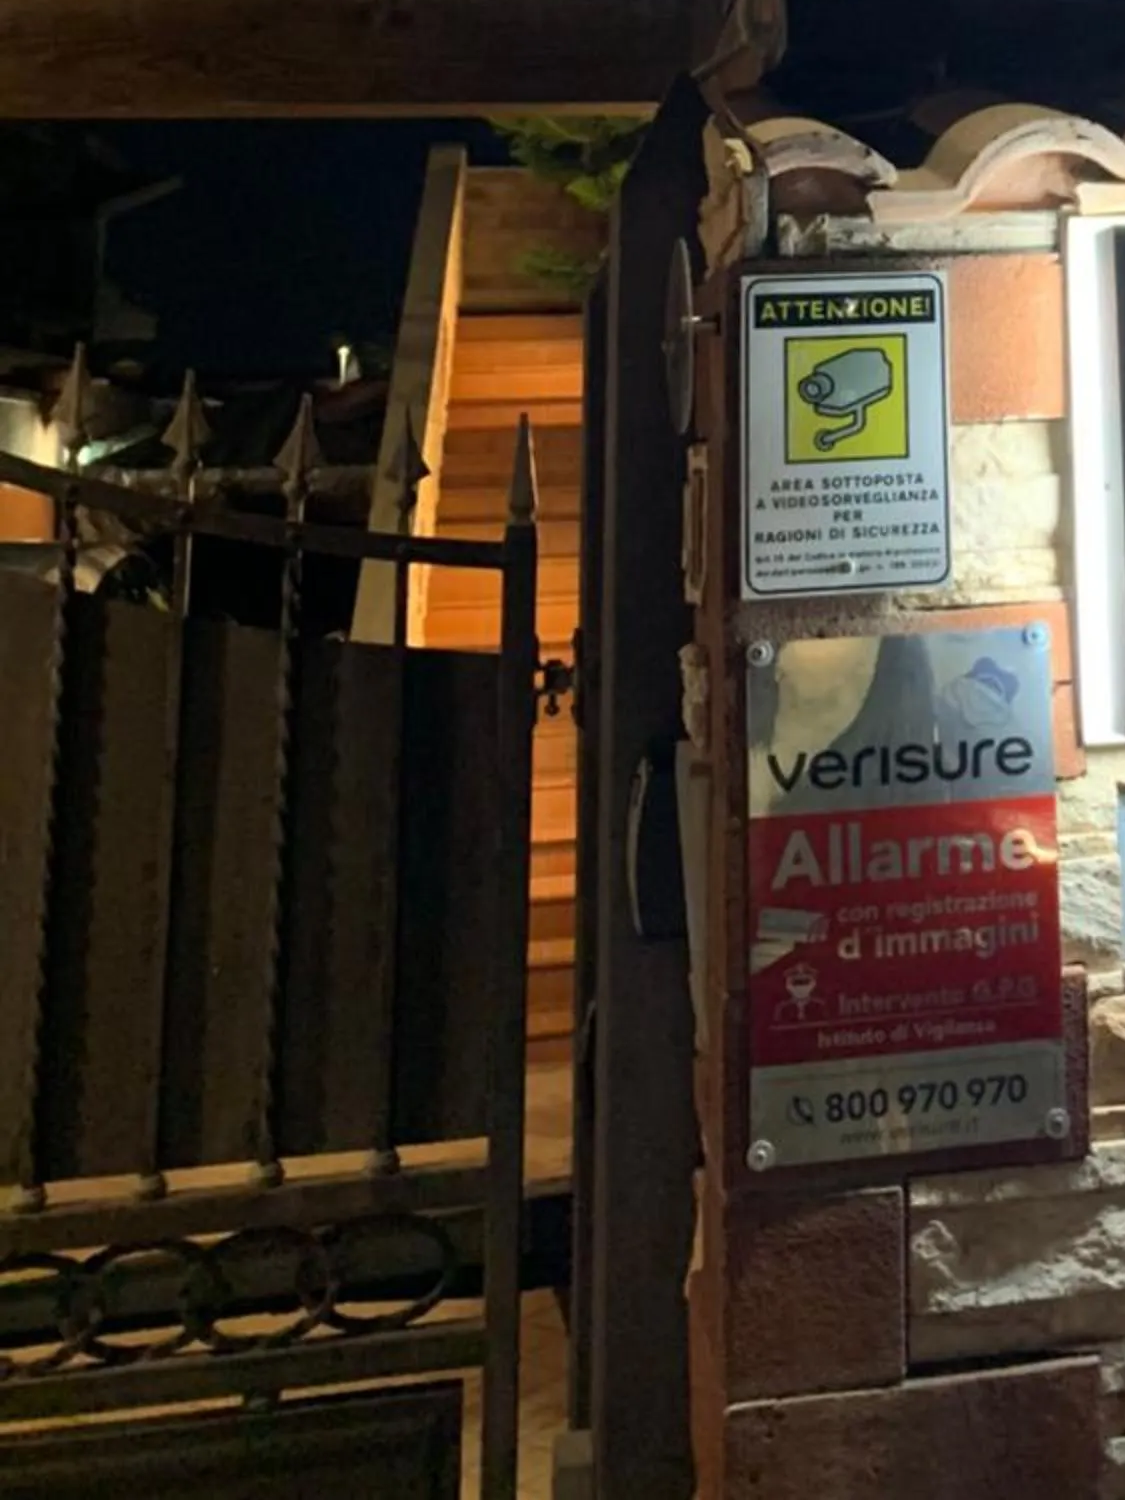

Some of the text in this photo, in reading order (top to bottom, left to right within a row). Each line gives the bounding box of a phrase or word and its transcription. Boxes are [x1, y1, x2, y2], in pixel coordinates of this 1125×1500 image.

[770, 474, 924, 492] AREA SOTTOPOSTA
[755, 489, 939, 510] A VIDEOSORVEGLIANZA
[832, 510, 863, 523] PER
[754, 521, 940, 544] RAGIONI DI SICUREZZA
[767, 736, 1034, 793] verisure
[771, 824, 1036, 891] Allarme
[836, 889, 1038, 924] con registrazione
[825, 1074, 1028, 1124] 800 970 970
